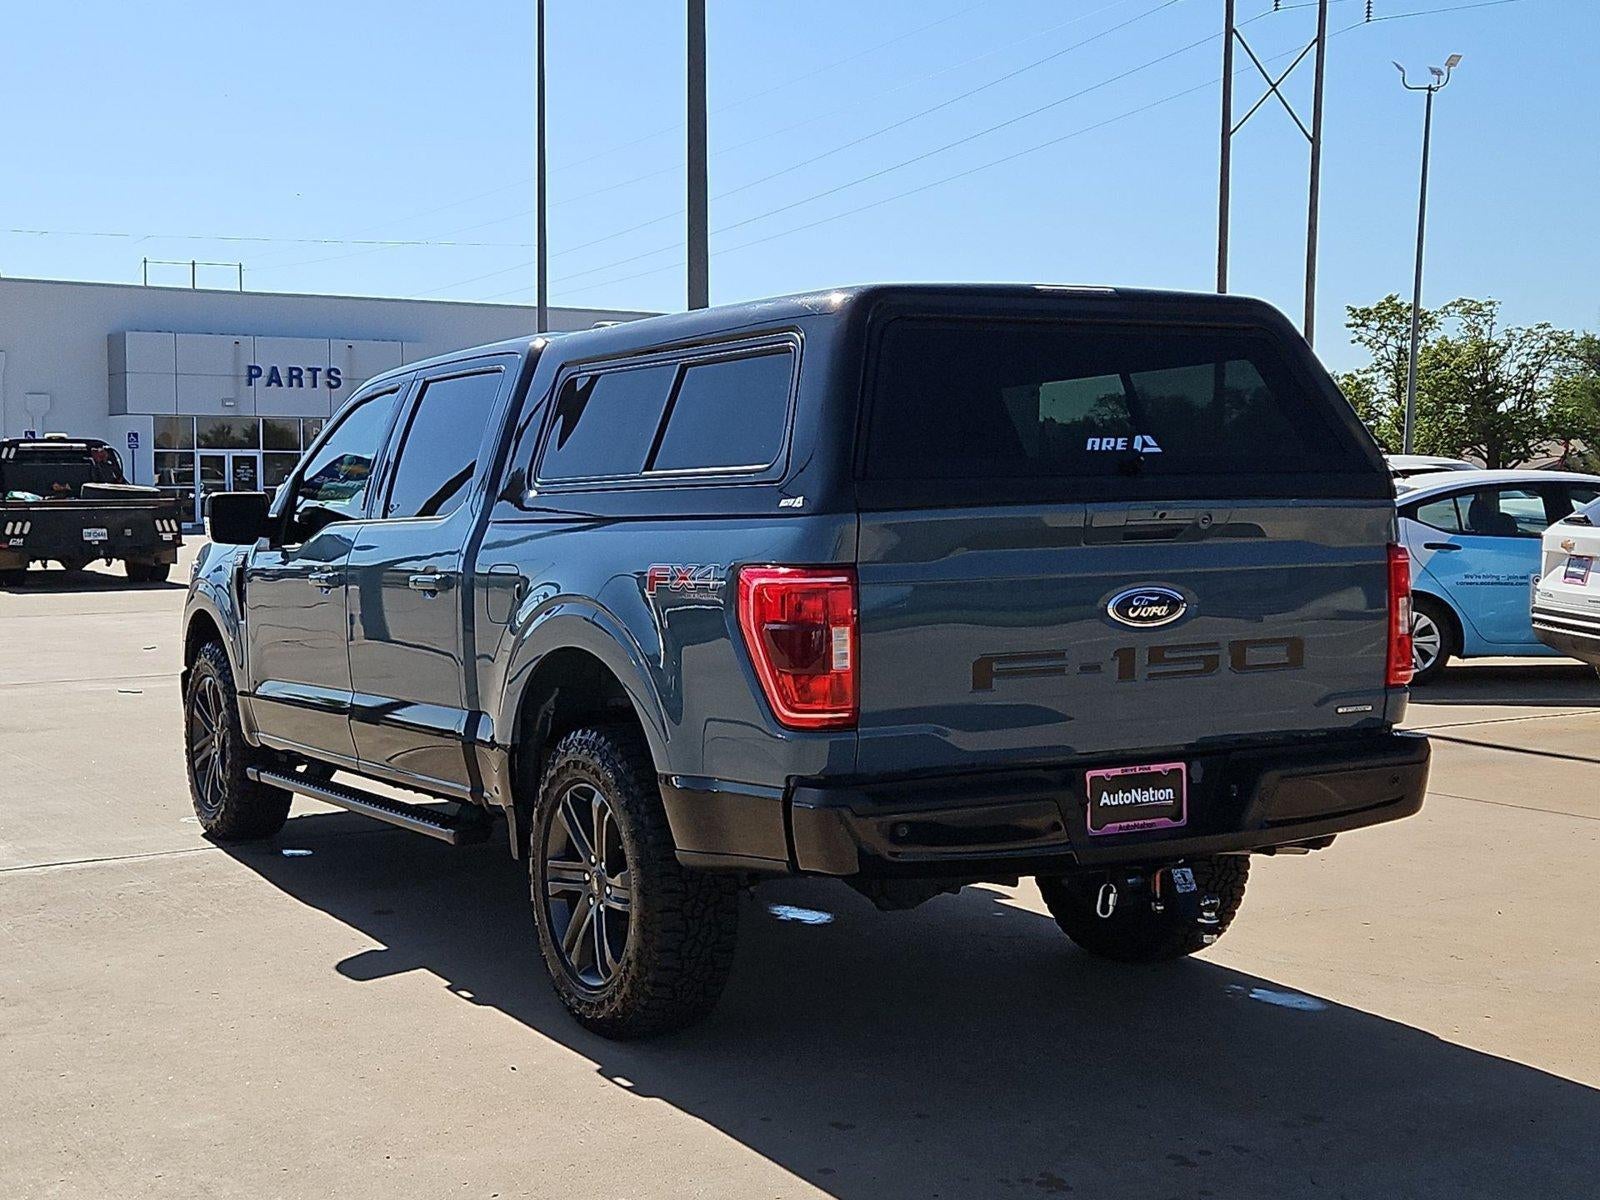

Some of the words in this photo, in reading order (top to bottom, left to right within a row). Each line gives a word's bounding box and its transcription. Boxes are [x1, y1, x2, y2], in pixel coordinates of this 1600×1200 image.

[247, 365, 342, 388] PARTS
[1086, 437, 1128, 450] ARE
[647, 563, 725, 597] FX4
[1507, 573, 1518, 581] join
[1128, 596, 1169, 617] Ford
[971, 637, 1304, 692] F-150
[1099, 787, 1175, 806] AutoNation
